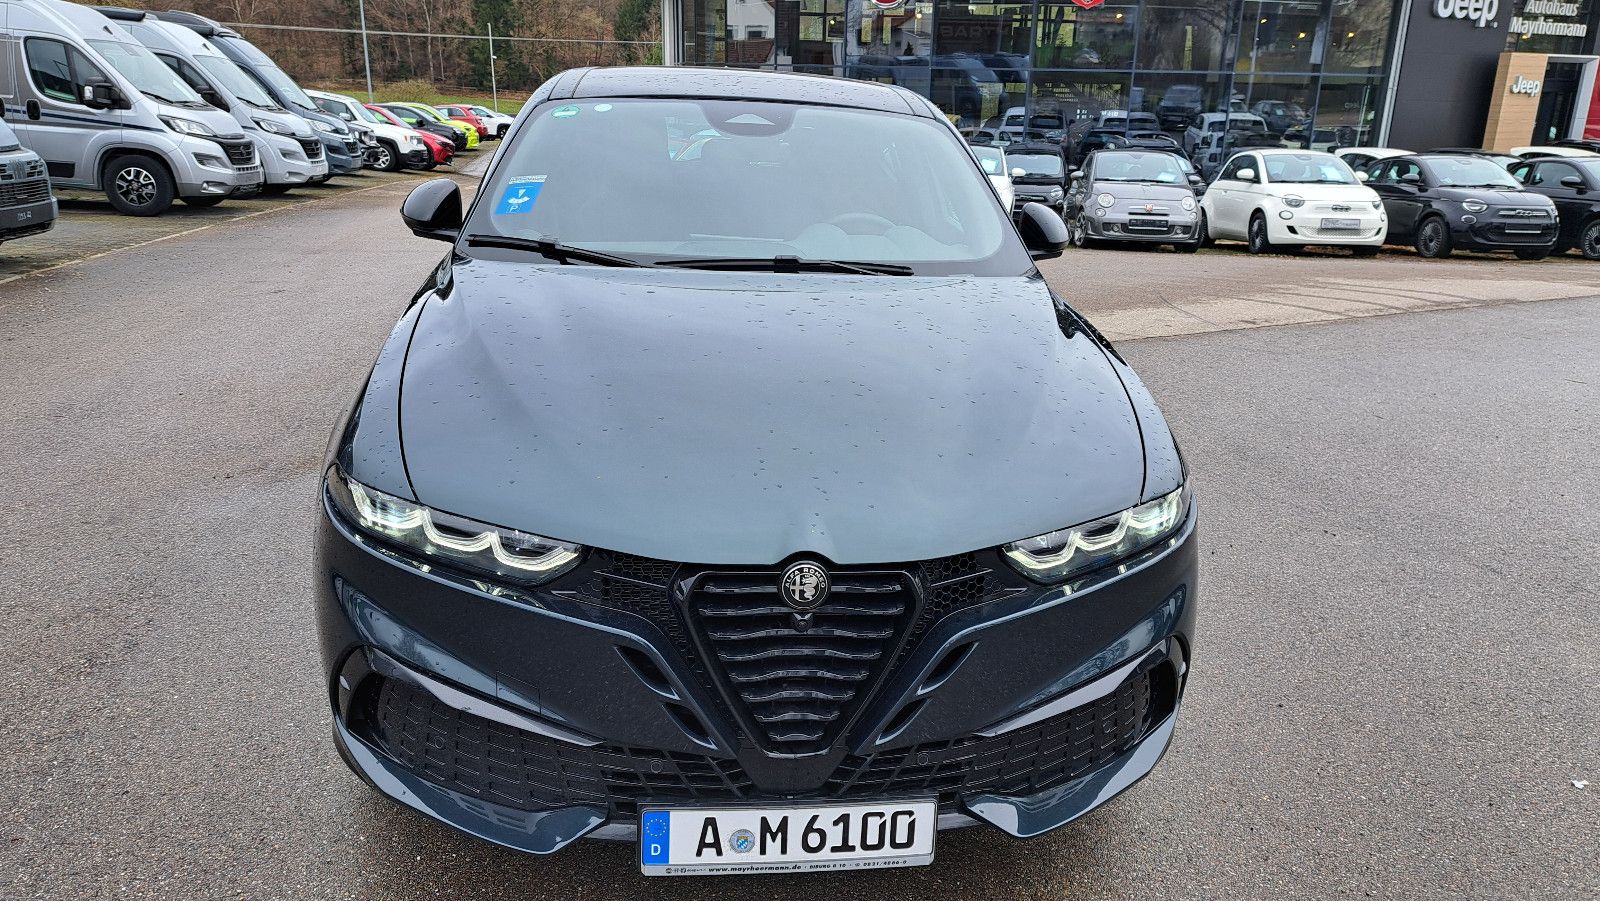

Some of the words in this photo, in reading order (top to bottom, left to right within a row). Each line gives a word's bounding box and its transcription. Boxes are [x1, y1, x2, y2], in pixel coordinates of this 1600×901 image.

[1523, 0, 1579, 16] Autohaus
[1508, 16, 1587, 38] Mayrhörmann
[1512, 75, 1541, 97] Jeep
[785, 570, 801, 588] ALFA
[803, 567, 826, 588] ROMEO
[695, 816, 724, 858] A
[759, 815, 790, 856] M
[801, 809, 917, 854] 6100
[650, 843, 661, 856] D
[708, 864, 802, 873] www.mayrhoermann.de
